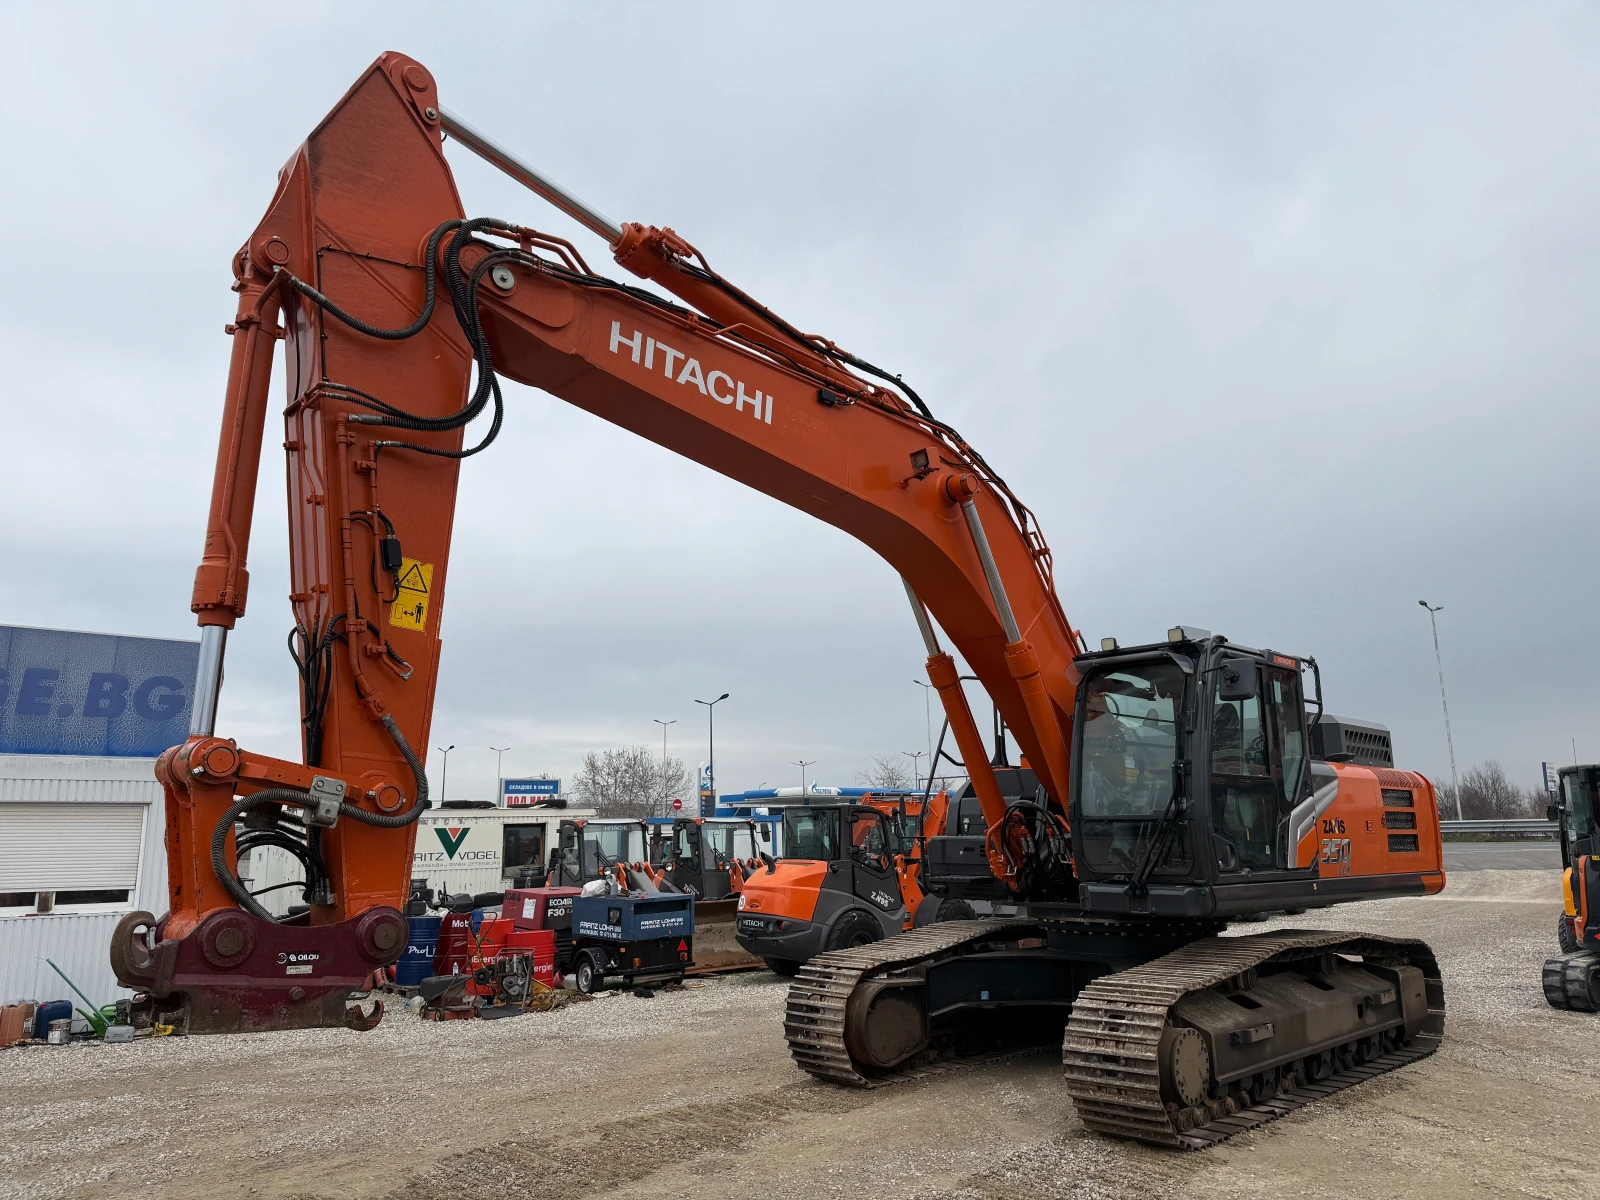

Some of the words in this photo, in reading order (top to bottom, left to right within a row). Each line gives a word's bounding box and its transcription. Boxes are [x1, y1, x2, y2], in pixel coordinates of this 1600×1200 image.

[609, 320, 774, 426] HITACHI
[413, 852, 444, 862] RITZ
[458, 850, 501, 861] VOGEL
[1320, 838, 1352, 864] 350
[549, 898, 573, 907] ECOAIR
[547, 908, 565, 917] F30
[742, 919, 764, 928] HITACHI
[407, 945, 437, 958] ProLi
